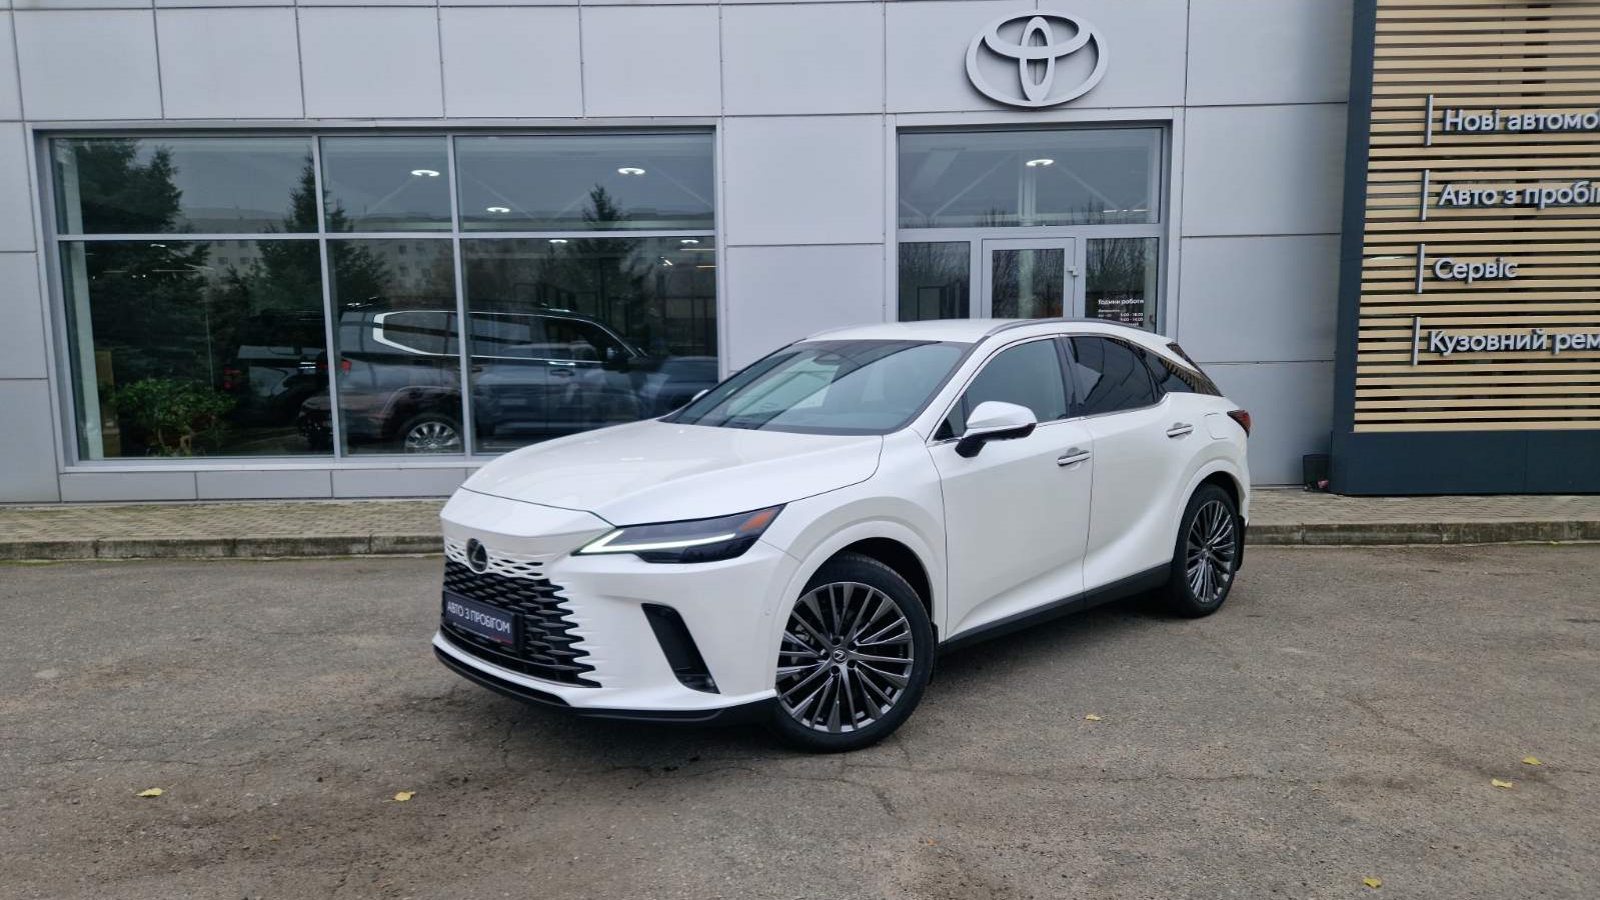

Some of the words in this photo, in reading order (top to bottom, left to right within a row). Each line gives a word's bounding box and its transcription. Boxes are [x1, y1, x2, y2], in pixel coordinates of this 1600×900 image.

[1444, 109, 1499, 131] Нові
[1507, 111, 1600, 130] автомо
[1439, 184, 1497, 206] Авто
[1503, 190, 1517, 205] з
[1434, 257, 1518, 284] Сервіс
[1430, 329, 1547, 357] Кузовний
[447, 601, 464, 617] АВТО
[470, 610, 511, 634] ПРОБІГОМ
